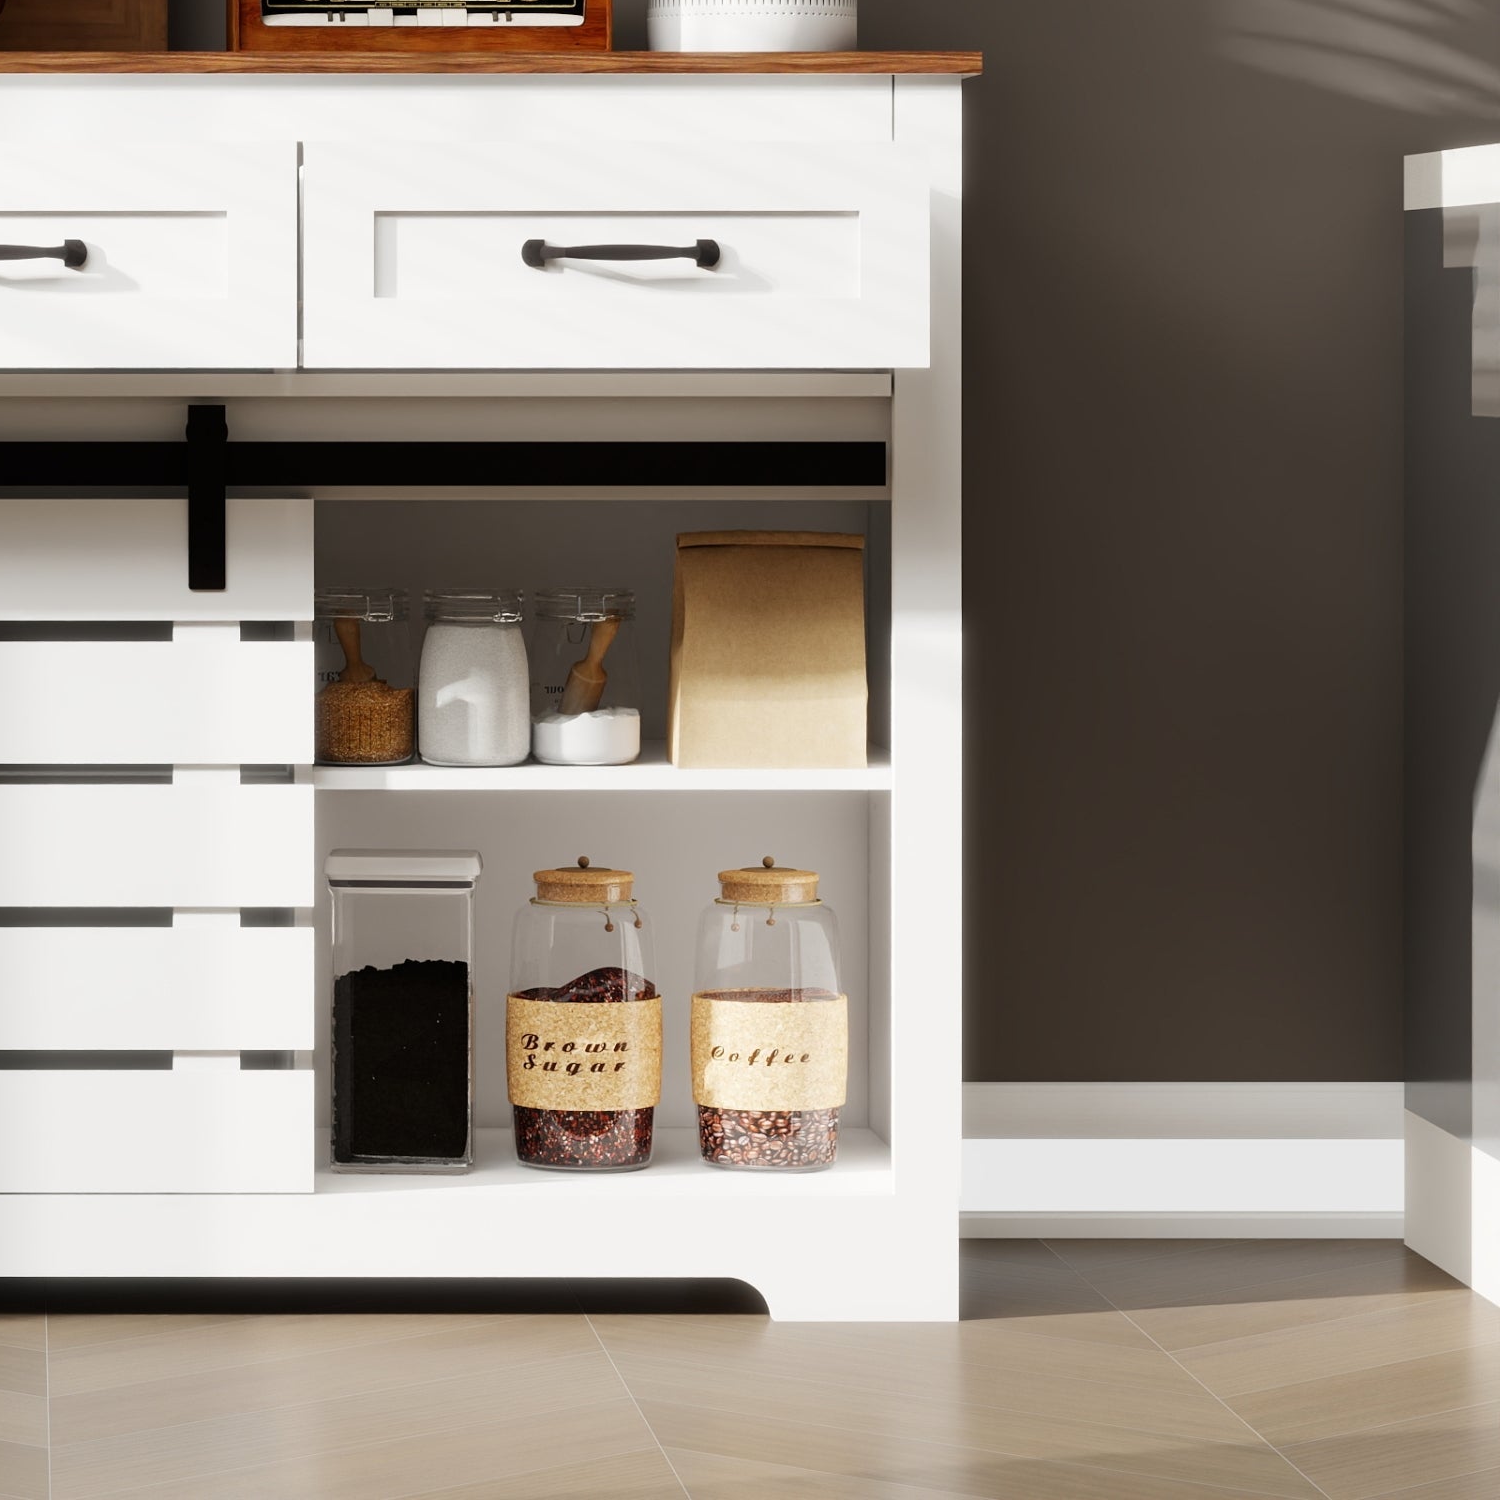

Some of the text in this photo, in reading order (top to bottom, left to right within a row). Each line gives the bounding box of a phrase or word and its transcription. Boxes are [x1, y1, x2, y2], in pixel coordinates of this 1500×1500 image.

[521, 1033, 628, 1052] Brown
[523, 1054, 625, 1076] Sugar
[711, 1046, 811, 1066] Coffee
